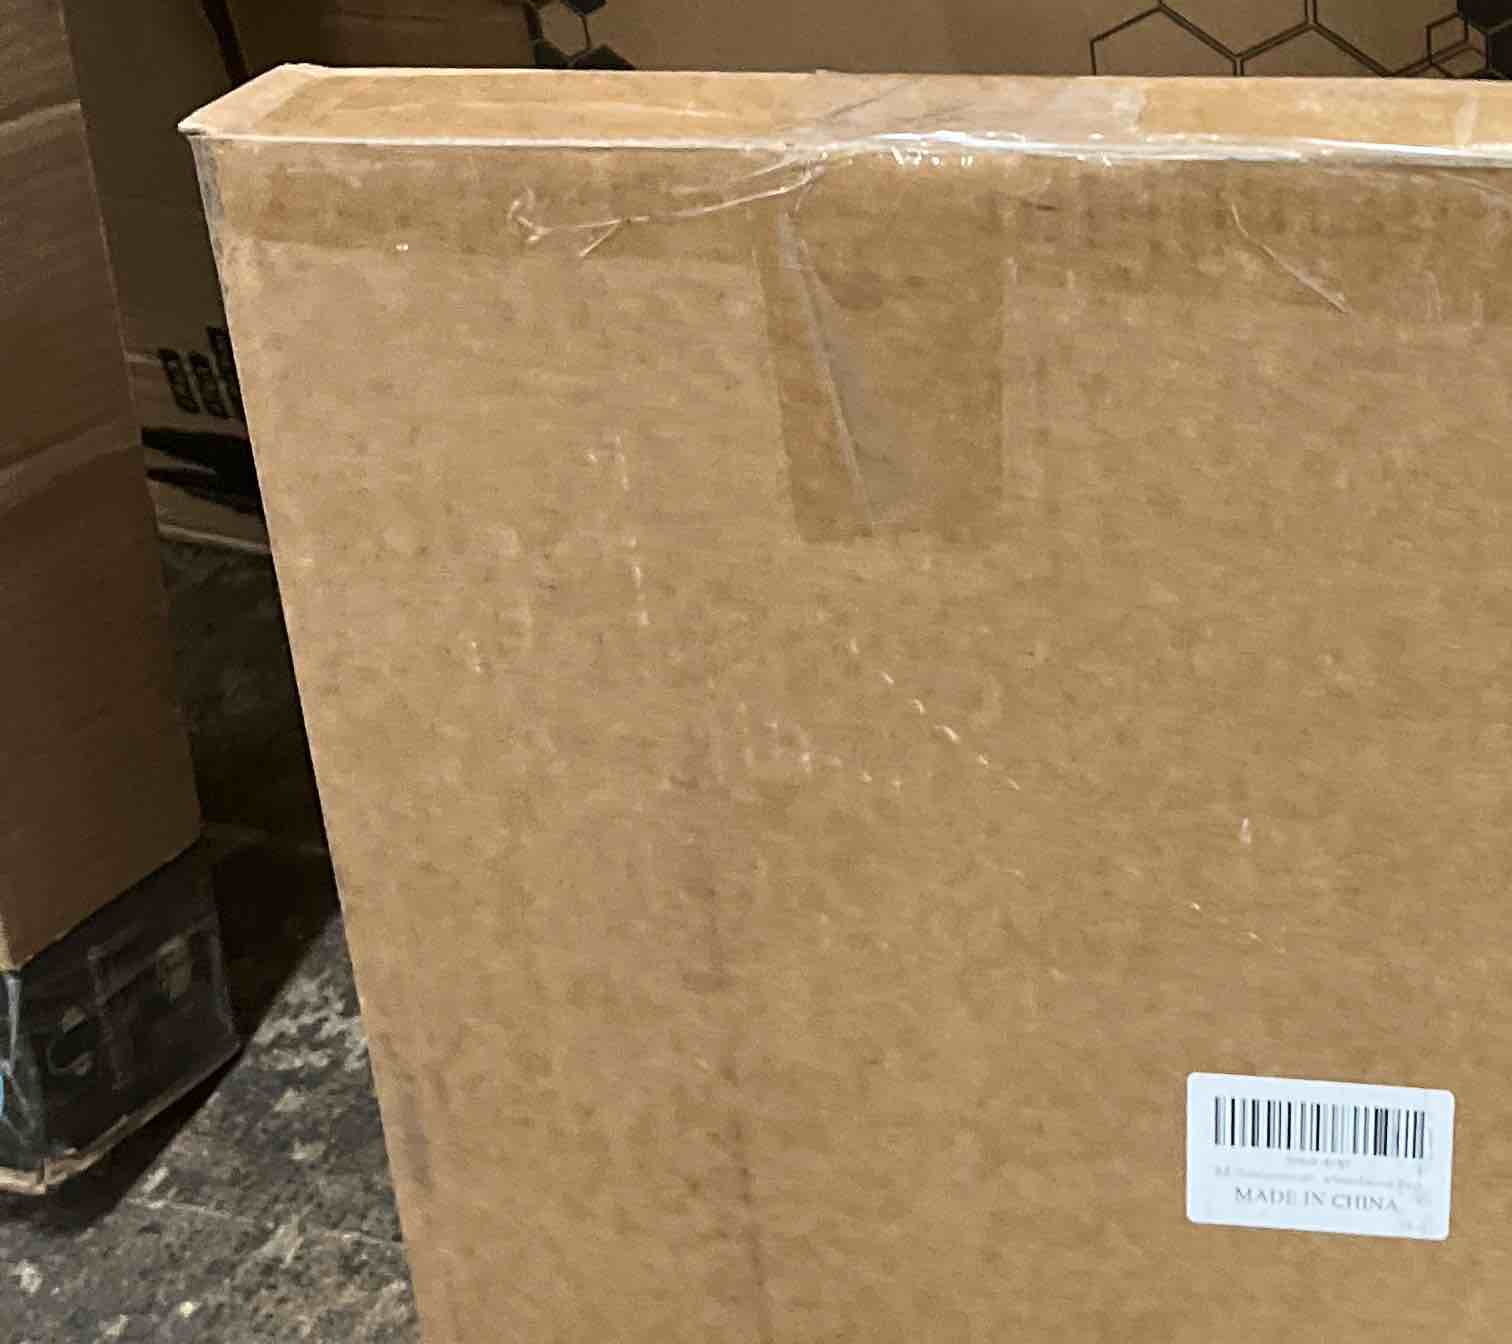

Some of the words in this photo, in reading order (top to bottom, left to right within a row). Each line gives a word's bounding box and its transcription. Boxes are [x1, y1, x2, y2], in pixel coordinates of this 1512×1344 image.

[1234, 1186, 1297, 1207] MADE
[1304, 1190, 1326, 1208] IN
[1331, 1192, 1400, 1213] CHINA
